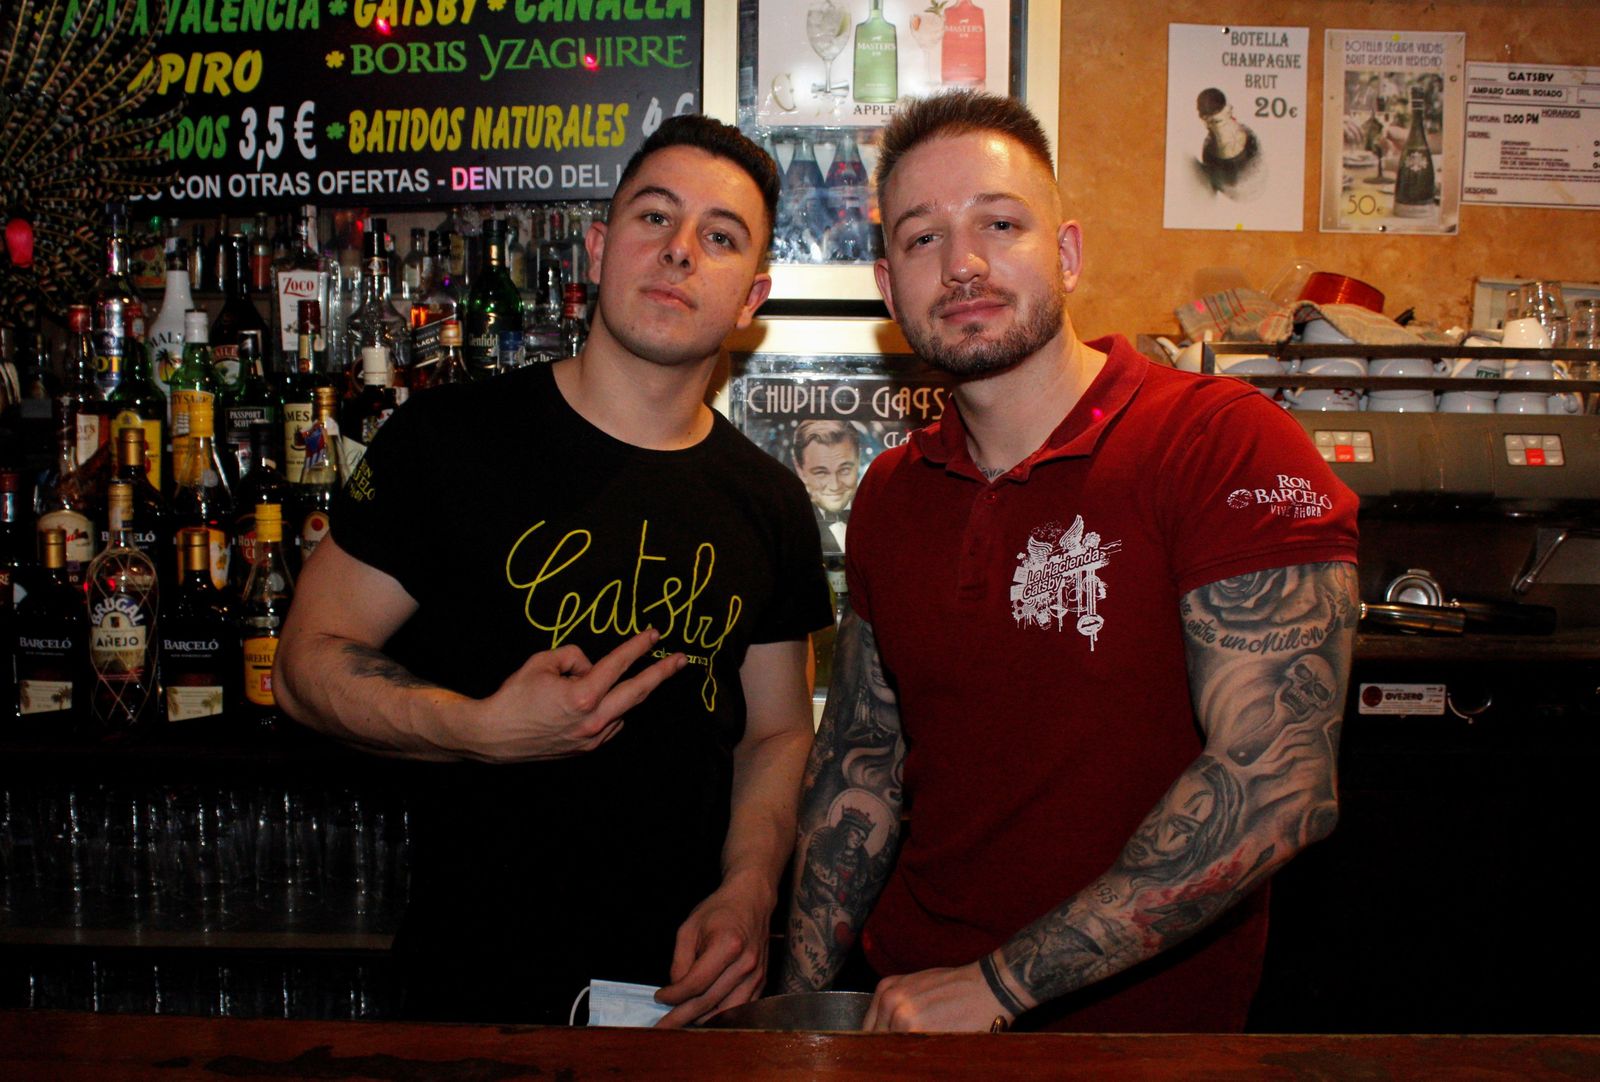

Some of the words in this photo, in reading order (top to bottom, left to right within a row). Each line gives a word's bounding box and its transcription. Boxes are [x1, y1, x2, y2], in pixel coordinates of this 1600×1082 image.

[165, 0, 320, 34] VALENCIA
[353, 0, 475, 28] GATSBY
[1231, 31, 1289, 48] BOTELLA
[350, 41, 467, 75] BORIS
[1222, 52, 1302, 69] CHAMPAGNE
[1245, 74, 1278, 89] BRUT
[1508, 71, 1555, 82] GATSBY
[1472, 86, 1503, 96] AMPARO
[1532, 88, 1563, 98] ROSADO
[853, 104, 895, 116] APPLE
[1503, 113, 1525, 124] 12:00
[1525, 112, 1540, 124] PM
[239, 106, 285, 172] 3,5
[294, 100, 317, 160] €
[349, 107, 465, 154] BATIDOS
[471, 103, 630, 152] NATURALES
[170, 174, 221, 200] CON
[228, 173, 310, 197] OTRAS
[318, 168, 430, 195] OFERTAS
[451, 165, 553, 192] DENTRO
[561, 163, 609, 189] DEL
[748, 384, 860, 415] CHUPITO
[872, 386, 952, 420] GATS
[229, 410, 262, 420] PASSPORT
[1276, 474, 1312, 491] RON
[1253, 487, 1333, 511] BARCELÓ
[1027, 569, 1042, 585] La
[1042, 547, 1101, 580] Hacienda
[1022, 575, 1063, 600] Gatsby
[91, 597, 145, 625] BRUGAL
[19, 636, 72, 651] BARCELÓ
[96, 634, 139, 648] AÑEJO
[163, 638, 219, 652] BARCELÓ
[1385, 692, 1424, 701] OVEJERO
